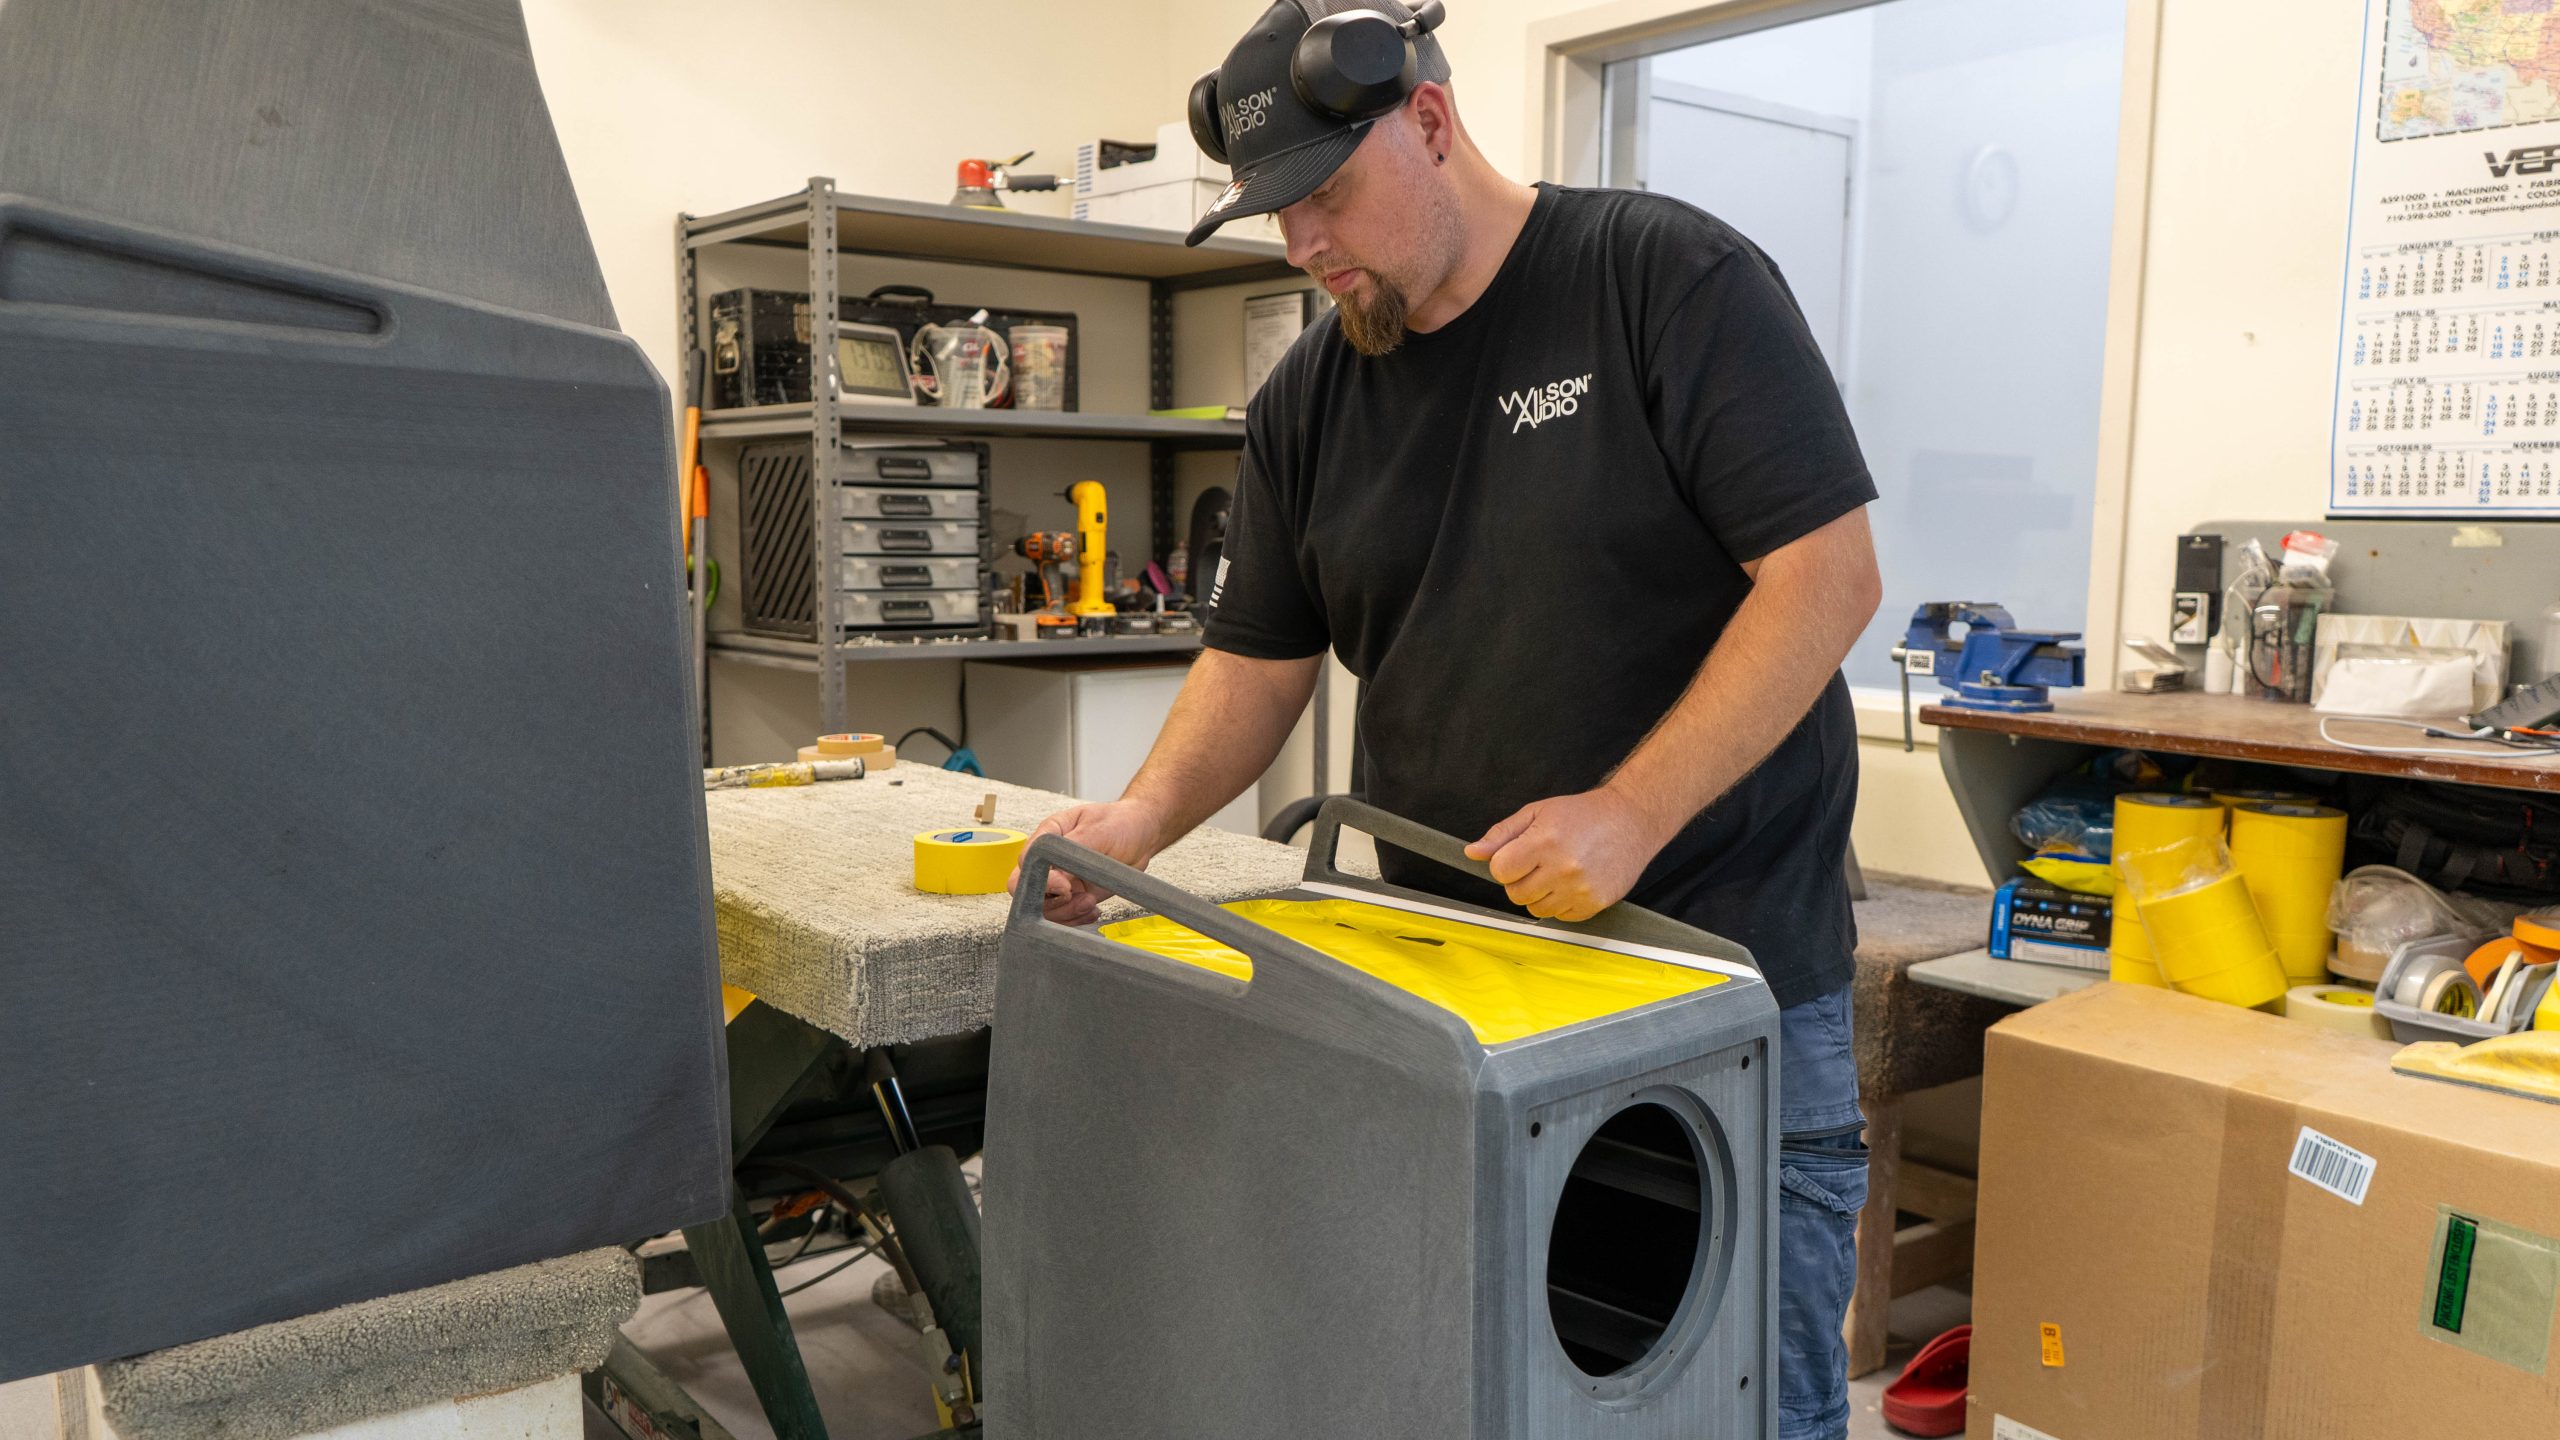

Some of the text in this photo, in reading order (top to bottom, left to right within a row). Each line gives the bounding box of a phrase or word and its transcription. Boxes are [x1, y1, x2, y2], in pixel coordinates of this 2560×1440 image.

[1228, 110, 1266, 144] AUDIO
[2446, 184, 2510, 198] MACHINING
[2475, 195, 2506, 205] DRIVE
[2395, 310, 2421, 318] APRIL
[2393, 377, 2414, 385] JULY
[1498, 374, 1588, 415] WILSON
[1512, 396, 1578, 434] AUDIO
[2012, 912, 2053, 931] DYNA
[2054, 917, 2091, 932] GRIP
[2444, 1266, 2459, 1286] LIST
[2438, 1286, 2457, 1326] PACKING
